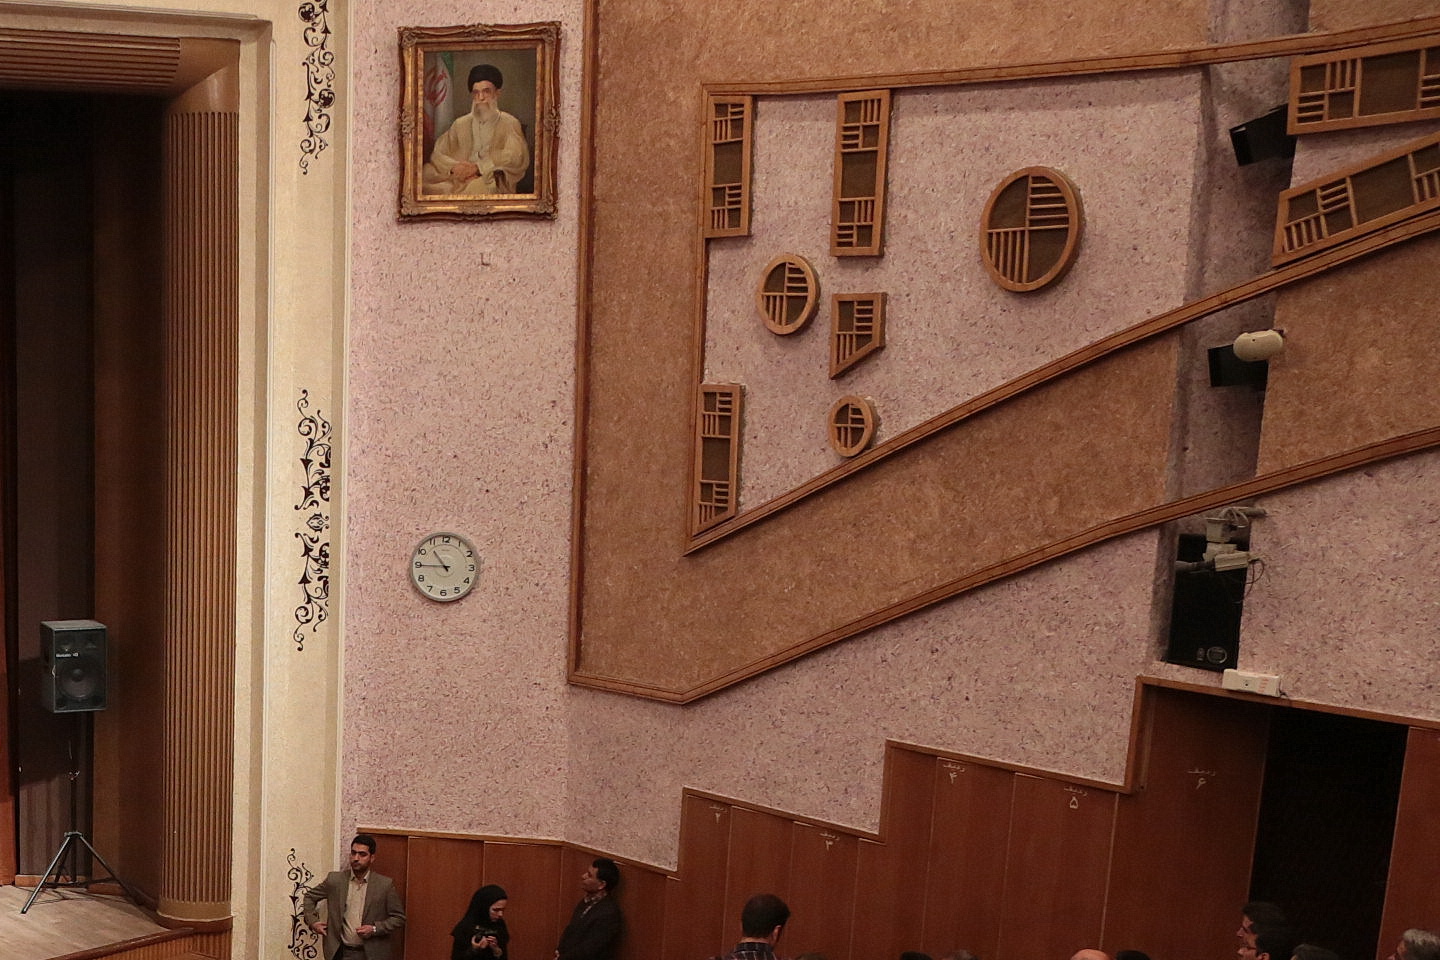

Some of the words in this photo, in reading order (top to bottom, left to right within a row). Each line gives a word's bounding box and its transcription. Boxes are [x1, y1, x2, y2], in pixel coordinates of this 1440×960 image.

[442, 536, 451, 544] 12
[466, 550, 473, 558] 2
[468, 564, 475, 572] 3
[1069, 796, 1079, 810] ۵
